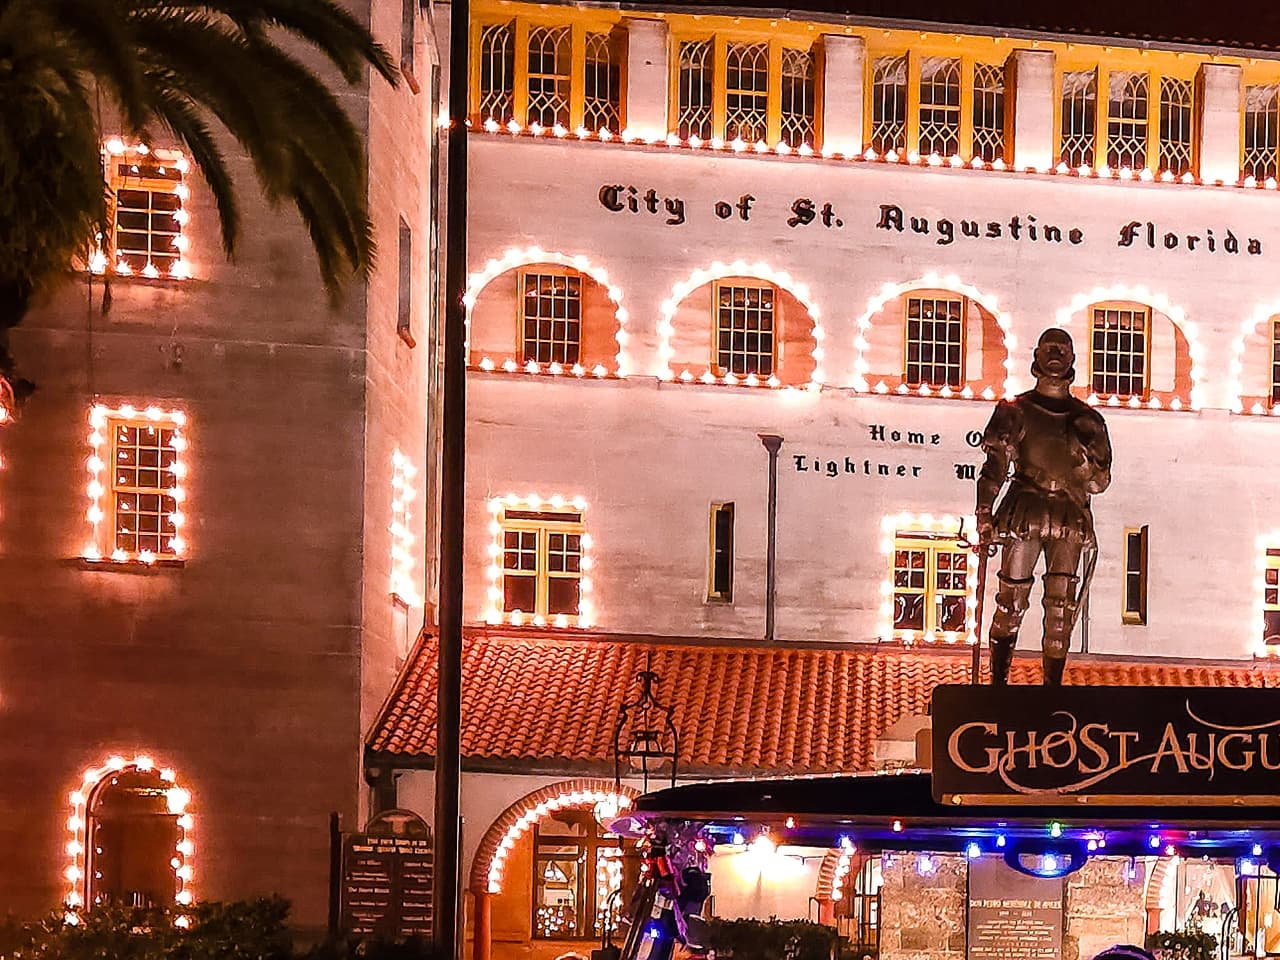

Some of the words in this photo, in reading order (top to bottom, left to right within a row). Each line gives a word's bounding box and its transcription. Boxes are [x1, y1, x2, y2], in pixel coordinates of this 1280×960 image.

[599, 184, 686, 226] City
[715, 194, 756, 222] of
[787, 198, 844, 228] St.
[876, 204, 1084, 246] Augustine
[1118, 220, 1262, 255] Florida
[869, 424, 941, 446] Home
[792, 454, 923, 480] Lightner
[947, 716, 1139, 786] GHOST
